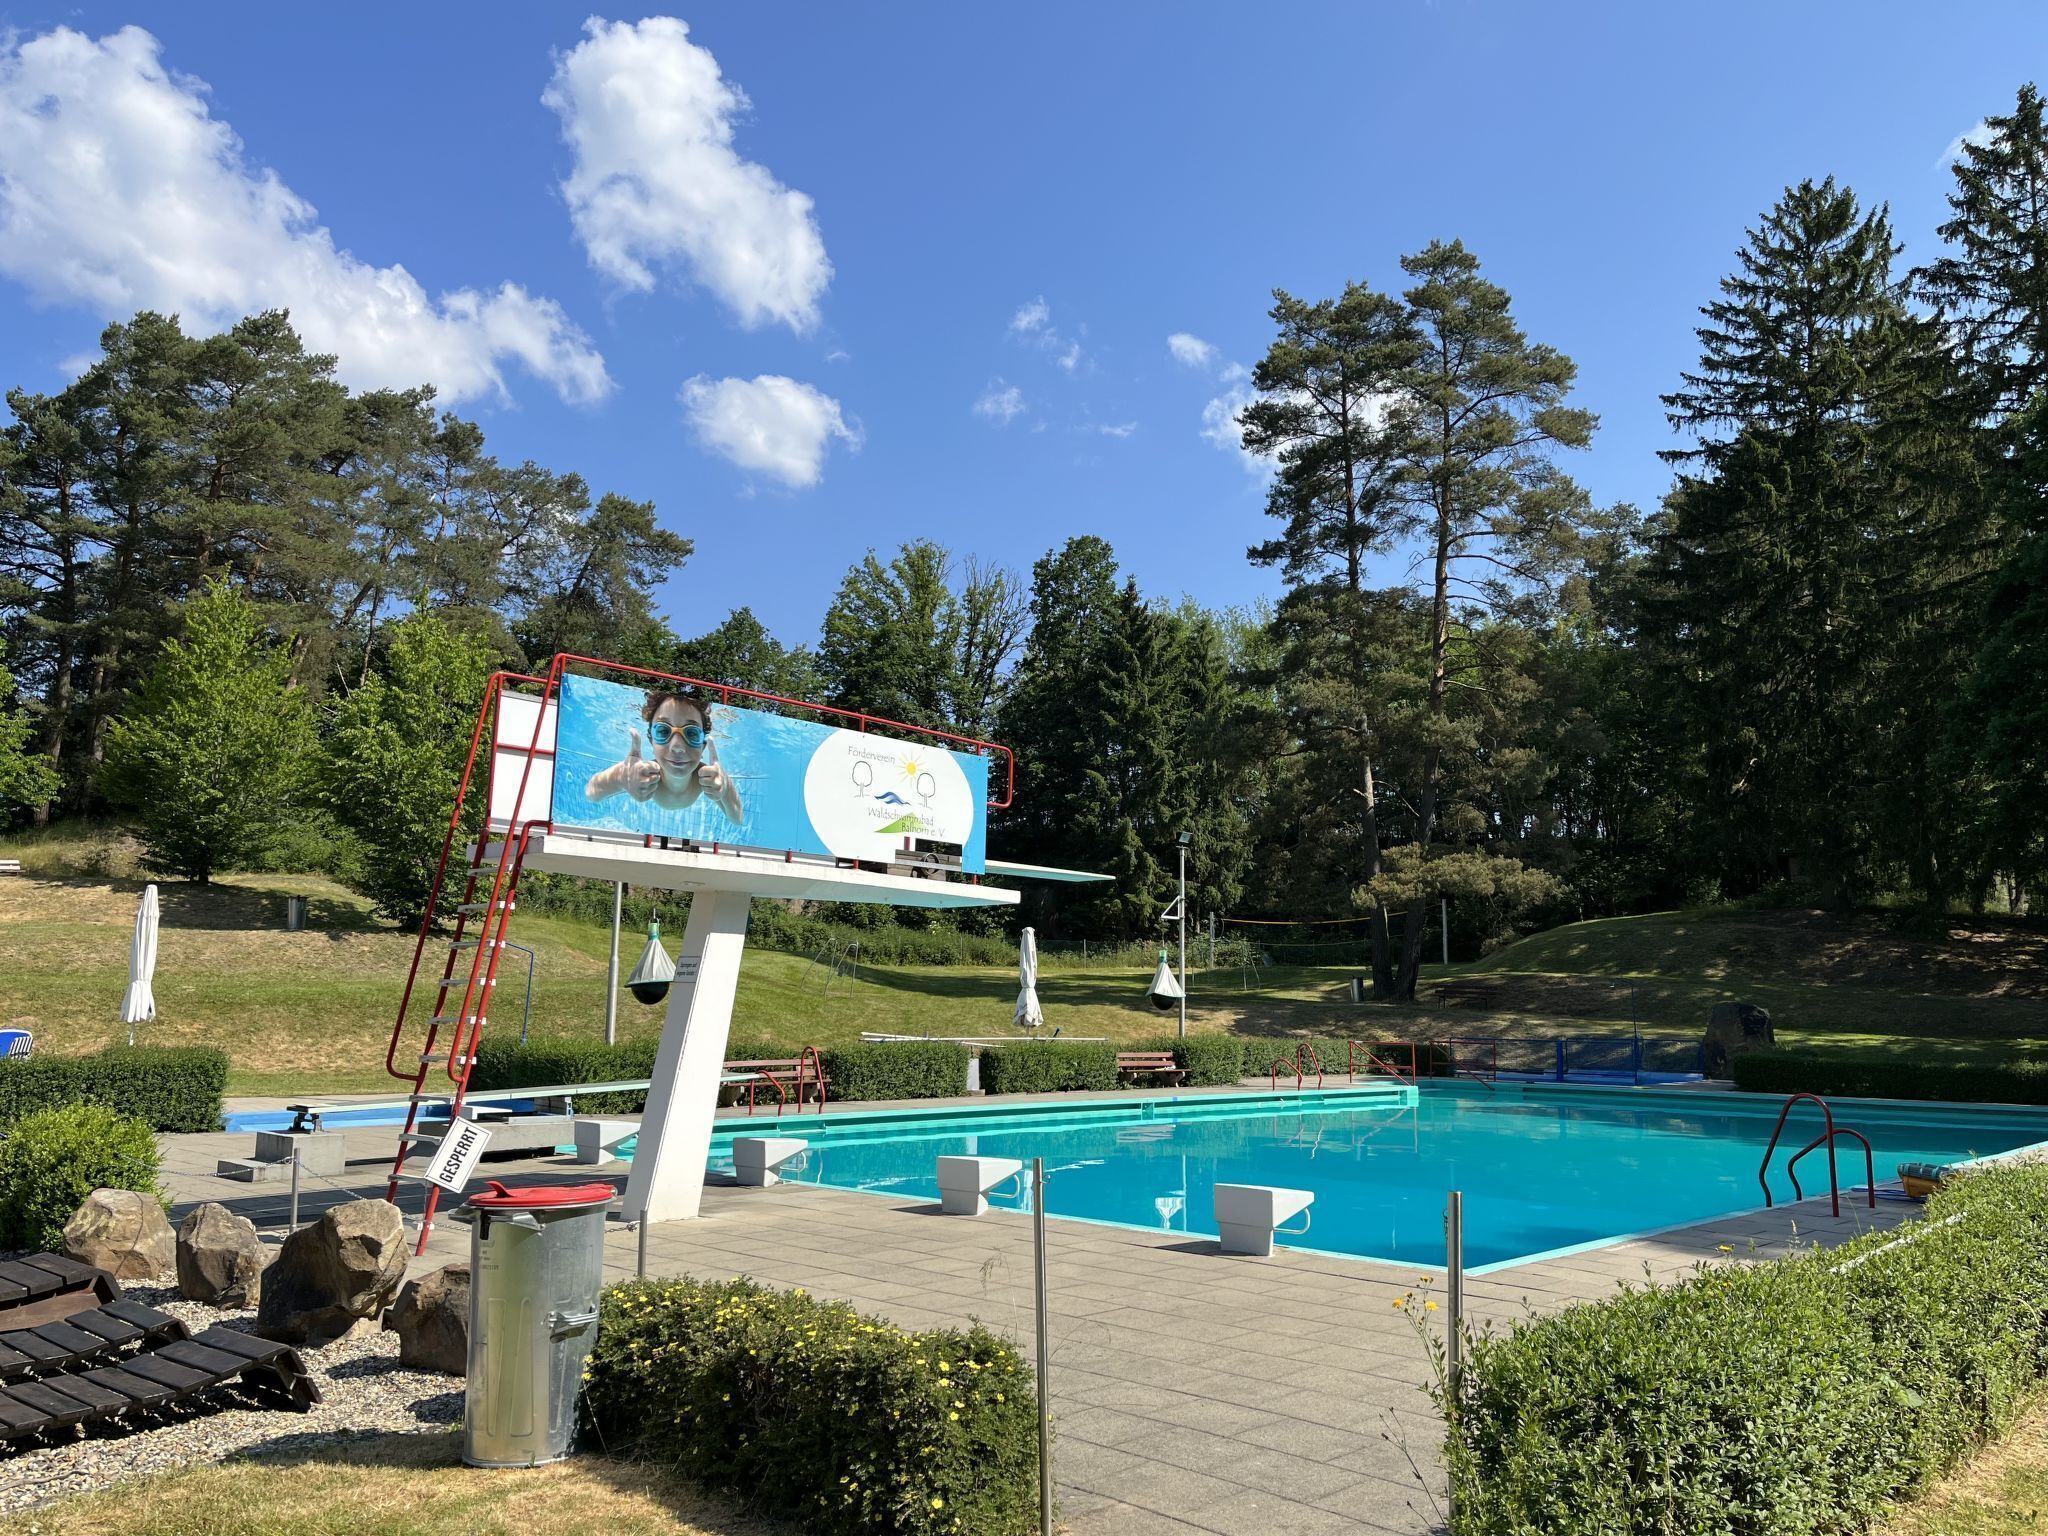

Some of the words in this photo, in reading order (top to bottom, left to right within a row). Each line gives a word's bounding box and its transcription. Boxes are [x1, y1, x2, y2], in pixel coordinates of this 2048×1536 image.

[848, 745, 896, 764] Förderverein
[868, 806, 934, 826] Waldschwimmbad
[439, 1126, 478, 1183] GESPERRT
